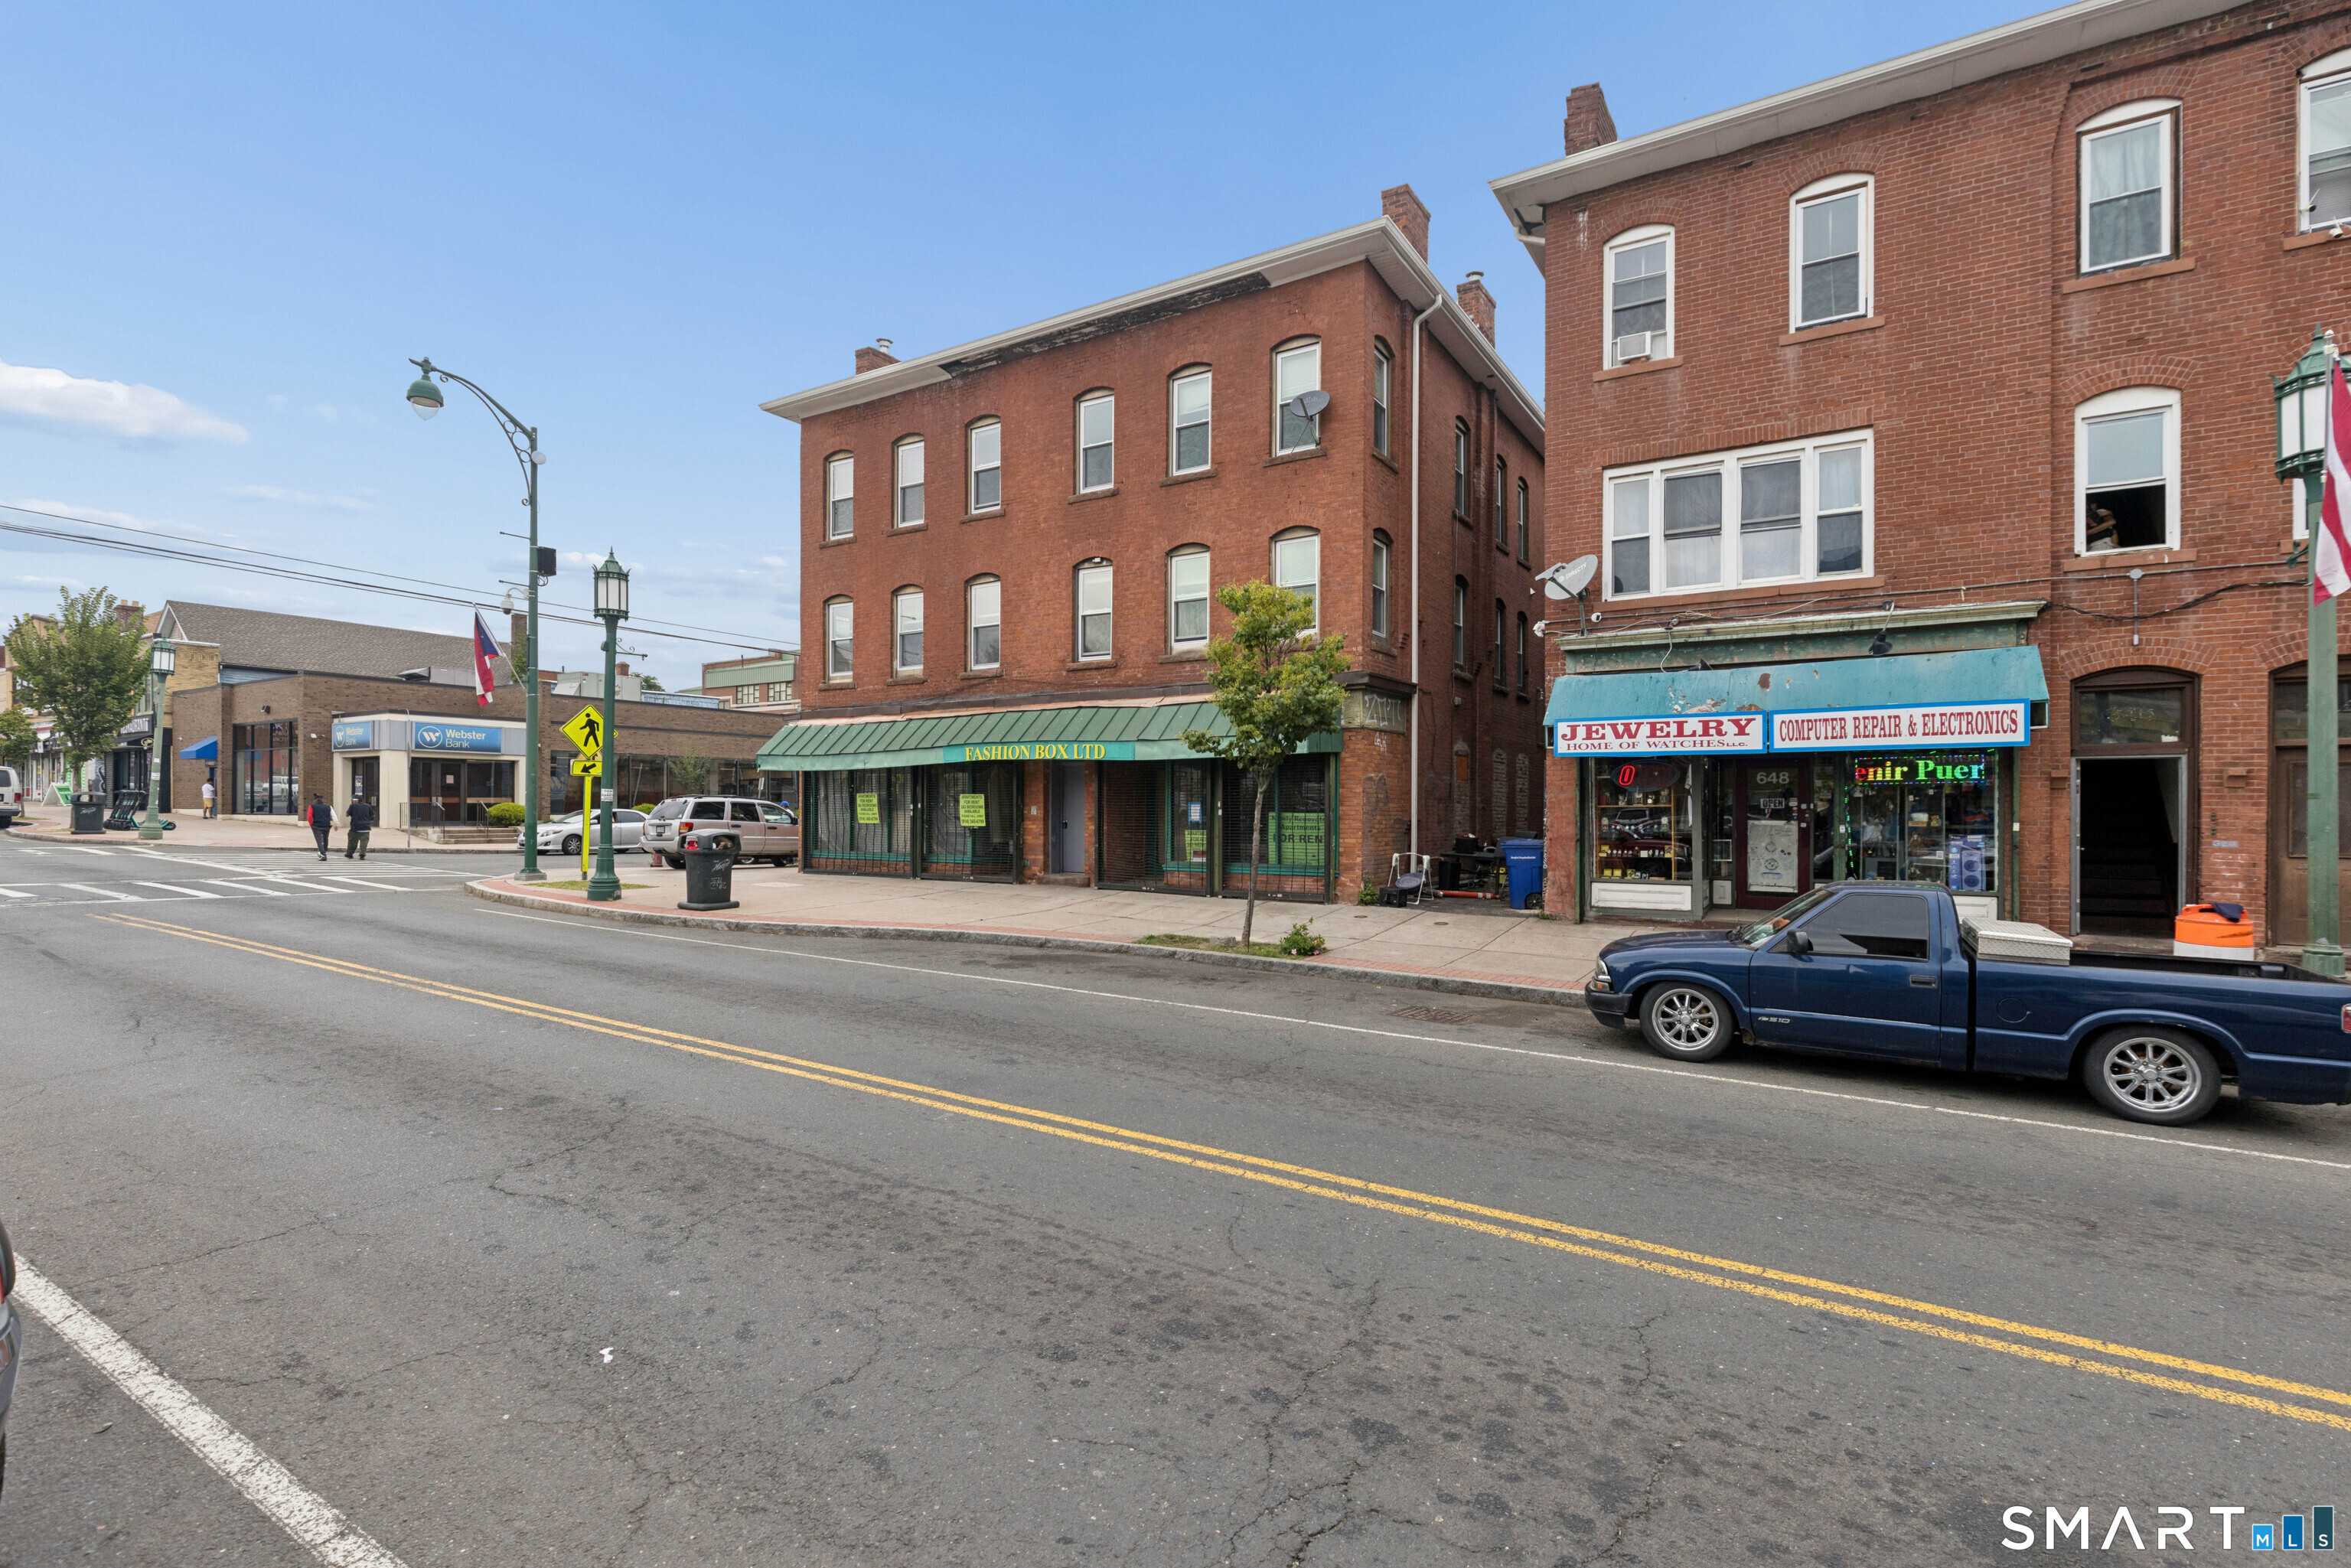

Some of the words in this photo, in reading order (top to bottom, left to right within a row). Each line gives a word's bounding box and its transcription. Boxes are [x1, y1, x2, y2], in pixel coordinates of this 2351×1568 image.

[1565, 562, 1586, 579] DIRECTV
[345, 725, 364, 736] Webster
[1560, 718, 1756, 742] JEWELRY
[1779, 717, 1848, 742] COMPUTER
[1853, 715, 1903, 739] REPAIR
[1908, 714, 1917, 737] &
[1922, 709, 2019, 736] ELECTRONICS
[445, 729, 486, 740] Webster
[345, 737, 357, 746] Bank
[445, 738, 470, 748] Bank
[1566, 742, 1612, 751] HOME
[1619, 742, 1640, 750] OF
[1646, 739, 1725, 749] WATCHES
[965, 745, 1032, 761] FASHION
[1035, 744, 1069, 759] BOX
[1073, 744, 1106, 759] LTD
[1855, 761, 1909, 781] enir
[1916, 760, 1984, 780] Puer
[1756, 772, 1789, 784] 648
[1762, 799, 1784, 808] OPEN
